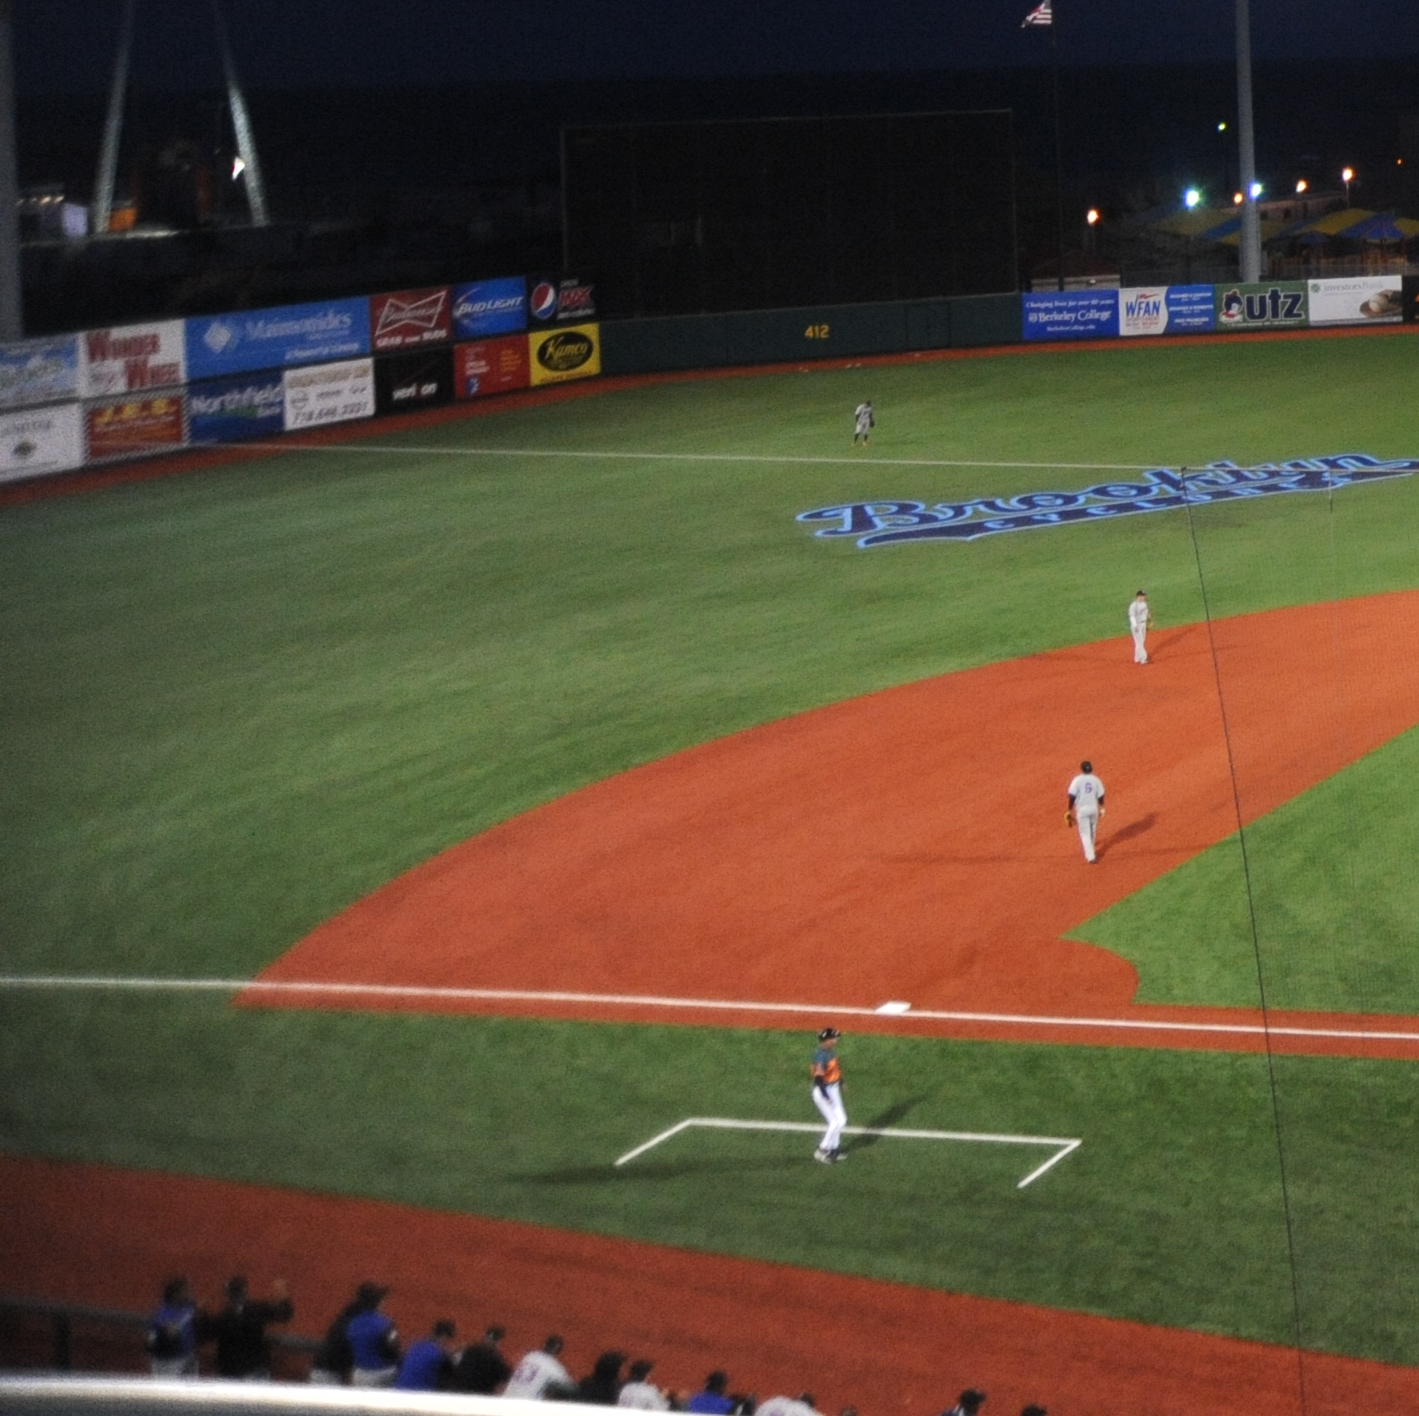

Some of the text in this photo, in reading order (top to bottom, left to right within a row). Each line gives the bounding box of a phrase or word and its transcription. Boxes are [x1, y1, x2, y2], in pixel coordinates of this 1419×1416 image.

[457, 296, 524, 314] BUD LIGHT
[1126, 296, 1160, 318] WFAN
[1245, 288, 1304, 322] utz
[1039, 309, 1112, 323] Berkeley College
[804, 324, 829, 339] 412
[544, 335, 589, 362] Kamco
[191, 384, 284, 414] Northfield
[393, 383, 438, 401] verion
